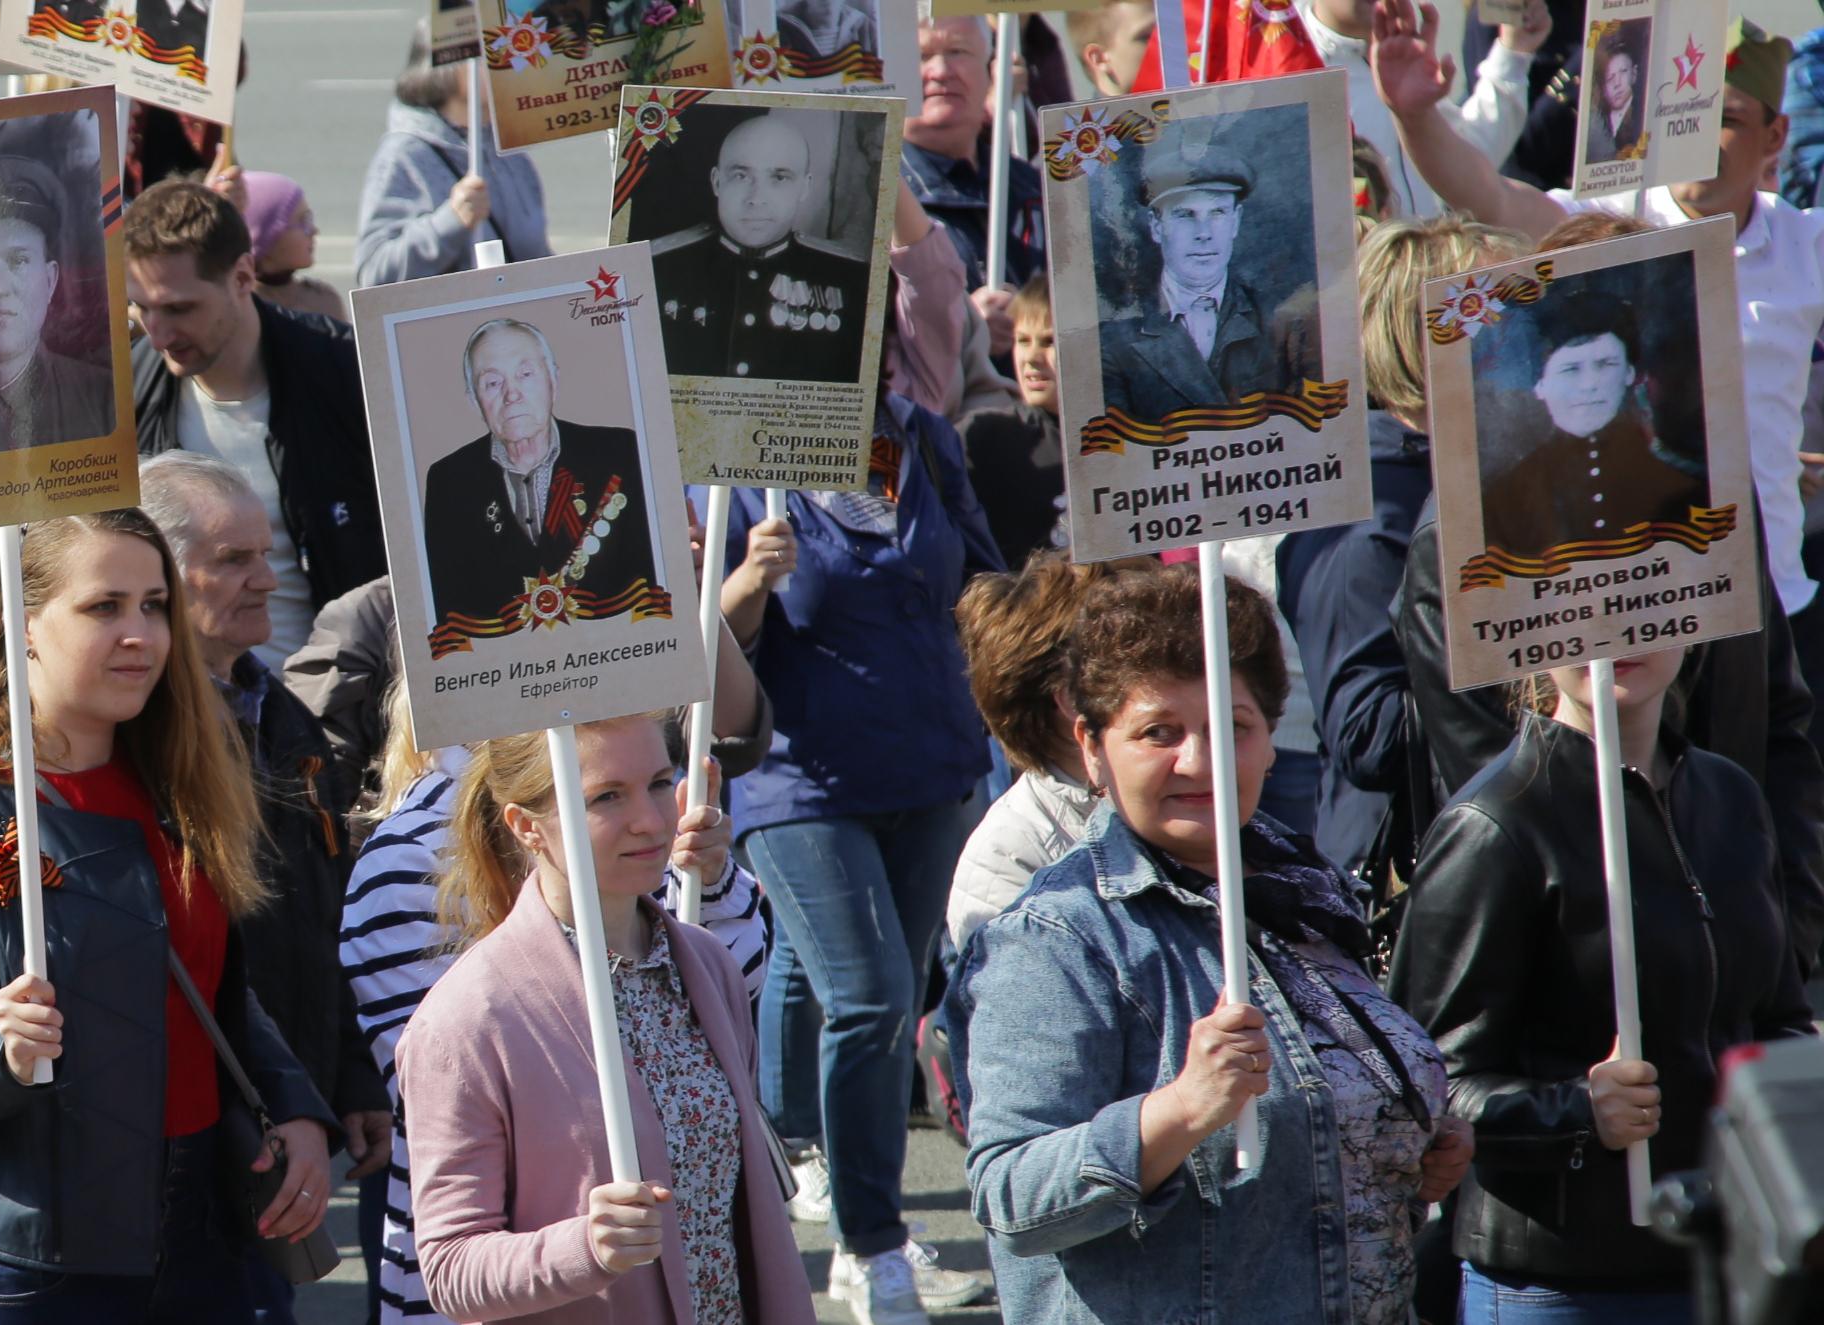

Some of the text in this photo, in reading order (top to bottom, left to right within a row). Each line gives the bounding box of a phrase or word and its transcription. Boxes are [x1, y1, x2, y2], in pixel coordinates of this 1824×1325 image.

[564, 58, 631, 85] ДЯТЛ
[516, 90, 568, 112] Иван
[545, 103, 621, 132] 1923-19
[591, 312, 626, 327] ПОЛК
[752, 429, 860, 451] Скорняков
[1153, 431, 1285, 470] Рядовой
[50, 452, 118, 474] Коробкин
[759, 446, 857, 467] Евлампий
[34, 468, 119, 493] Артемович
[706, 462, 856, 485] Александрович
[1093, 454, 1343, 516] Гарин Николай
[47, 484, 120, 503] красноармеец
[1128, 513, 1203, 544] 1902
[1237, 497, 1309, 528] 1941
[1533, 556, 1671, 600] Рядовой
[1472, 574, 1733, 643] Туриков Николай
[1507, 636, 1585, 668] 1903
[1621, 614, 1699, 646] 1946
[434, 637, 678, 693] Венгер Илья Алексеевич
[520, 674, 599, 699] Ефрейтор
